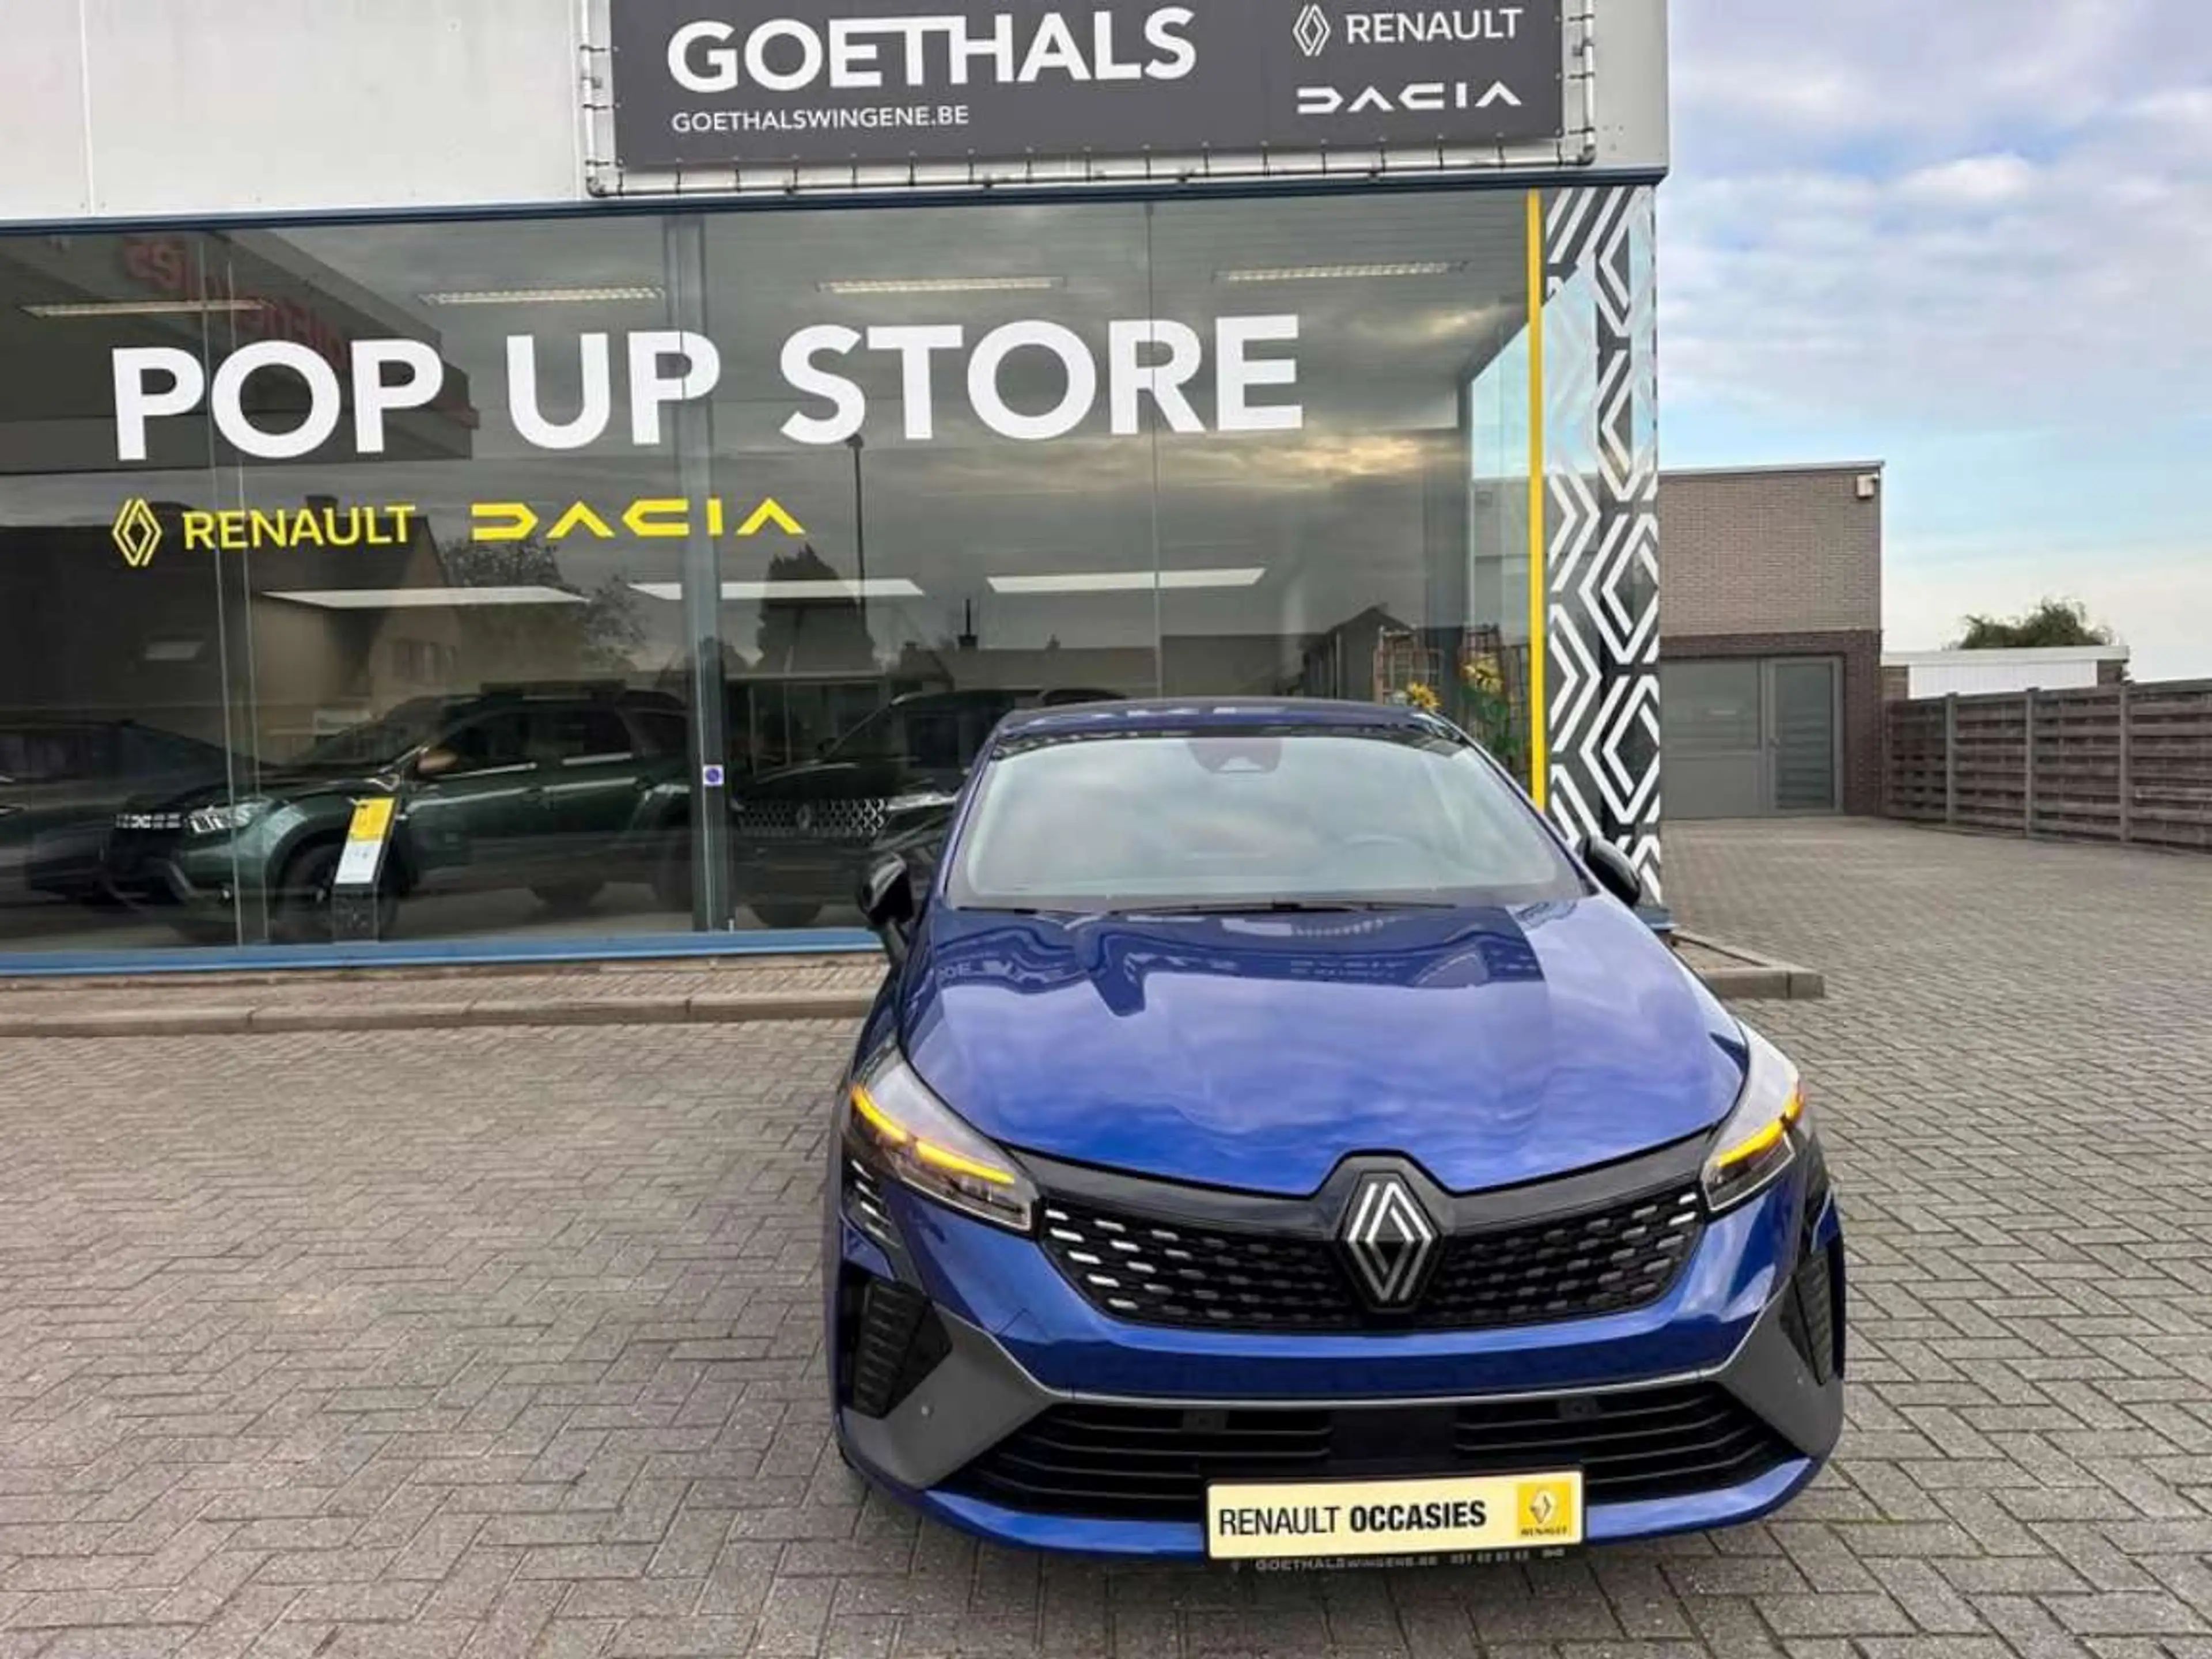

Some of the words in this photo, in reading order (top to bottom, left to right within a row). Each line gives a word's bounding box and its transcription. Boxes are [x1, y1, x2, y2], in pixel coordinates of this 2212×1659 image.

[1346, 8, 1522, 44] RENAULT
[667, 6, 1197, 93] GOETHALS
[1297, 81, 1522, 114] DACIA
[672, 105, 969, 132] GOETHALSWINGENE.BE
[112, 339, 444, 461] POP
[506, 329, 721, 450] UP
[780, 313, 1303, 445] STORE
[183, 503, 415, 550] RENAULT
[469, 496, 805, 542] DACIA
[1219, 1506, 1341, 1536] RENAULT
[1349, 1499, 1487, 1533] OCCASIES
